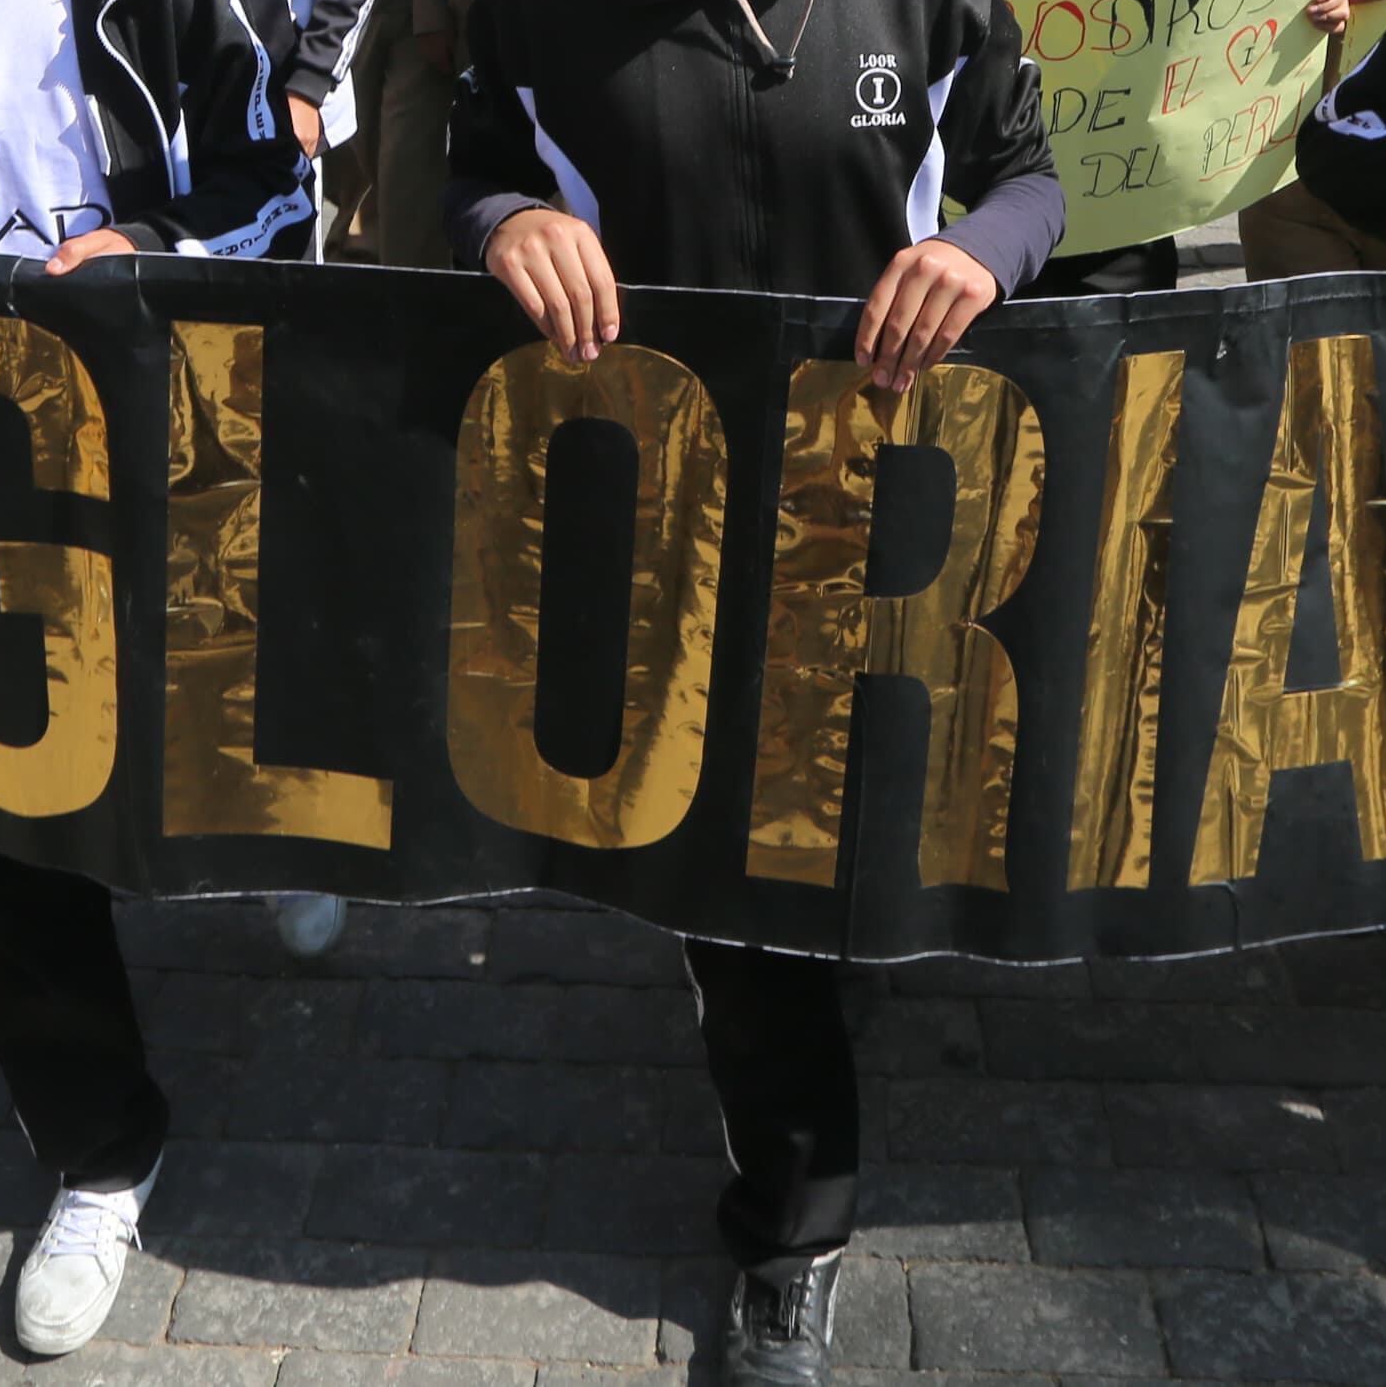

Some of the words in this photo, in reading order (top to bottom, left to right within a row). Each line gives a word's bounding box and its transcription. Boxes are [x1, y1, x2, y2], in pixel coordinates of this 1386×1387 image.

[859, 53, 897, 69] LOOR
[850, 112, 906, 127] GLORIA
[1081, 144, 1177, 198] DEL
